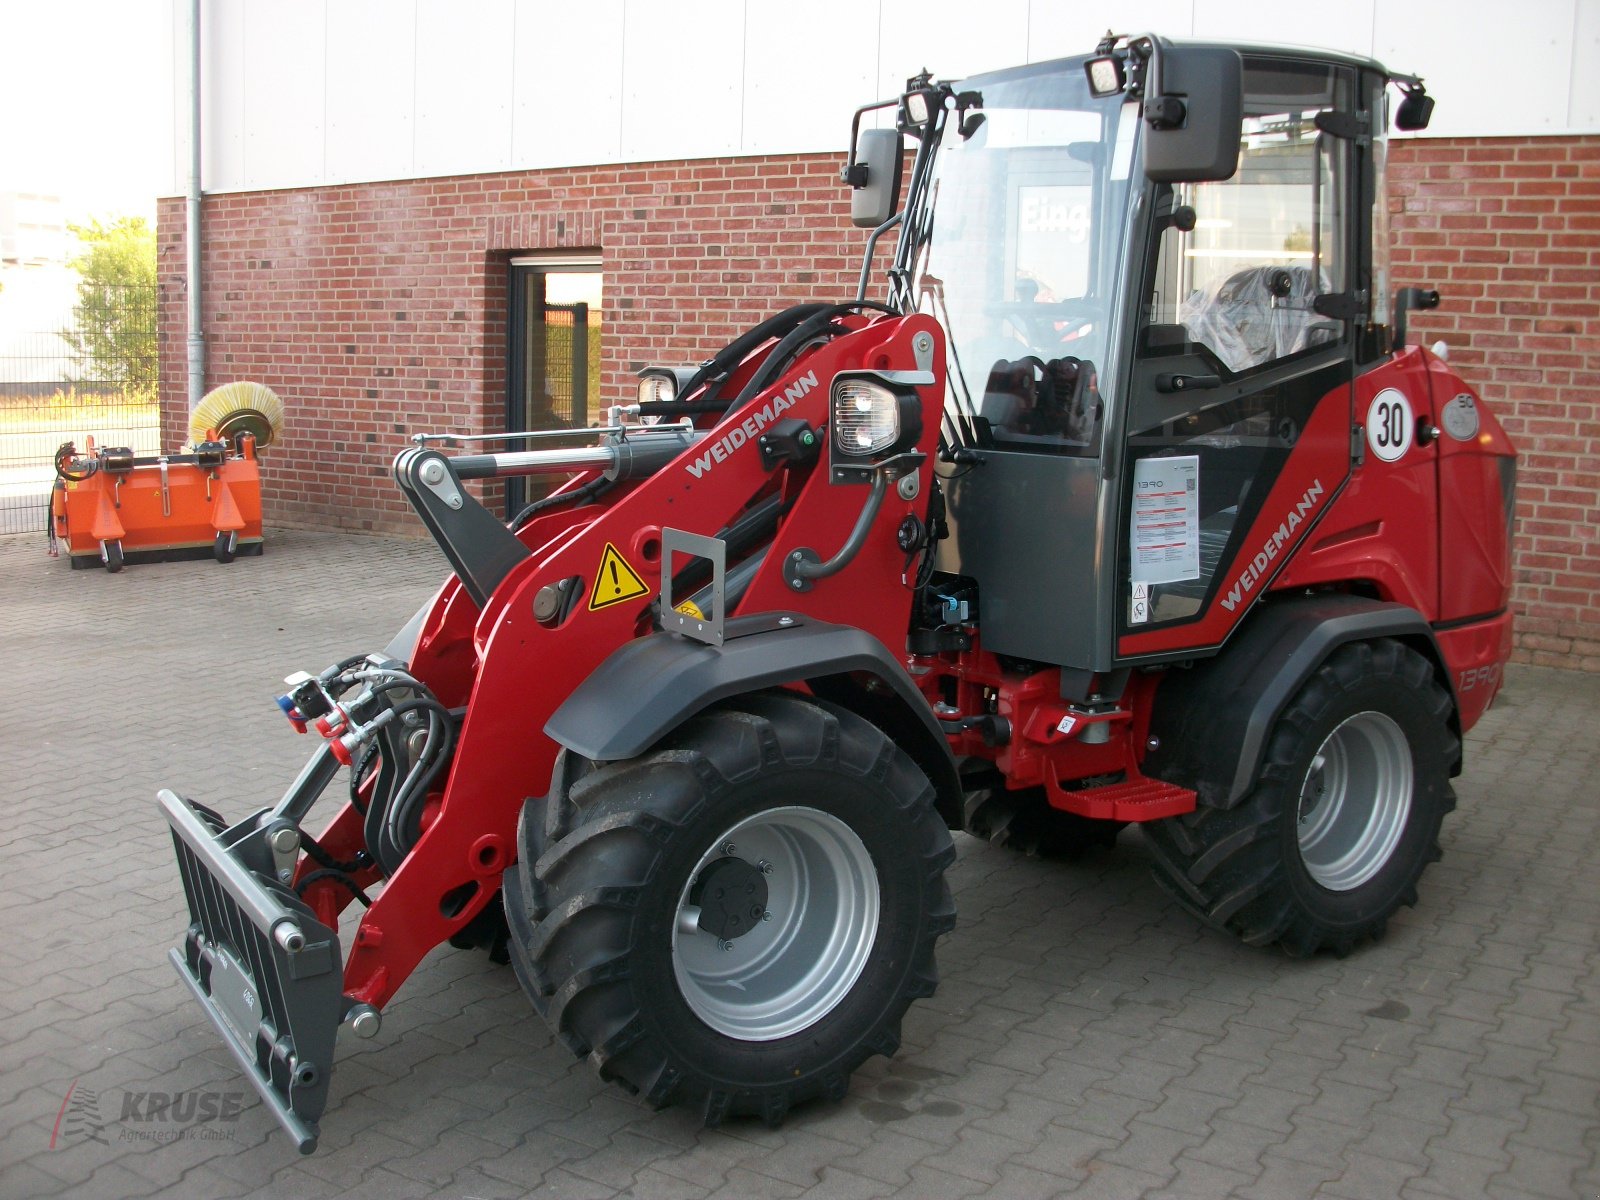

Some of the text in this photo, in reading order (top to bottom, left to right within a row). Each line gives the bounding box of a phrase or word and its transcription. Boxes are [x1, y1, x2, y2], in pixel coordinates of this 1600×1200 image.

[1021, 195, 1090, 243] Eing
[685, 369, 819, 479] WEIDEMANN
[1377, 402, 1403, 447] 30
[1137, 480, 1164, 489] 1390
[1220, 478, 1325, 612] WEIDEMANN
[1458, 662, 1499, 693] 1390
